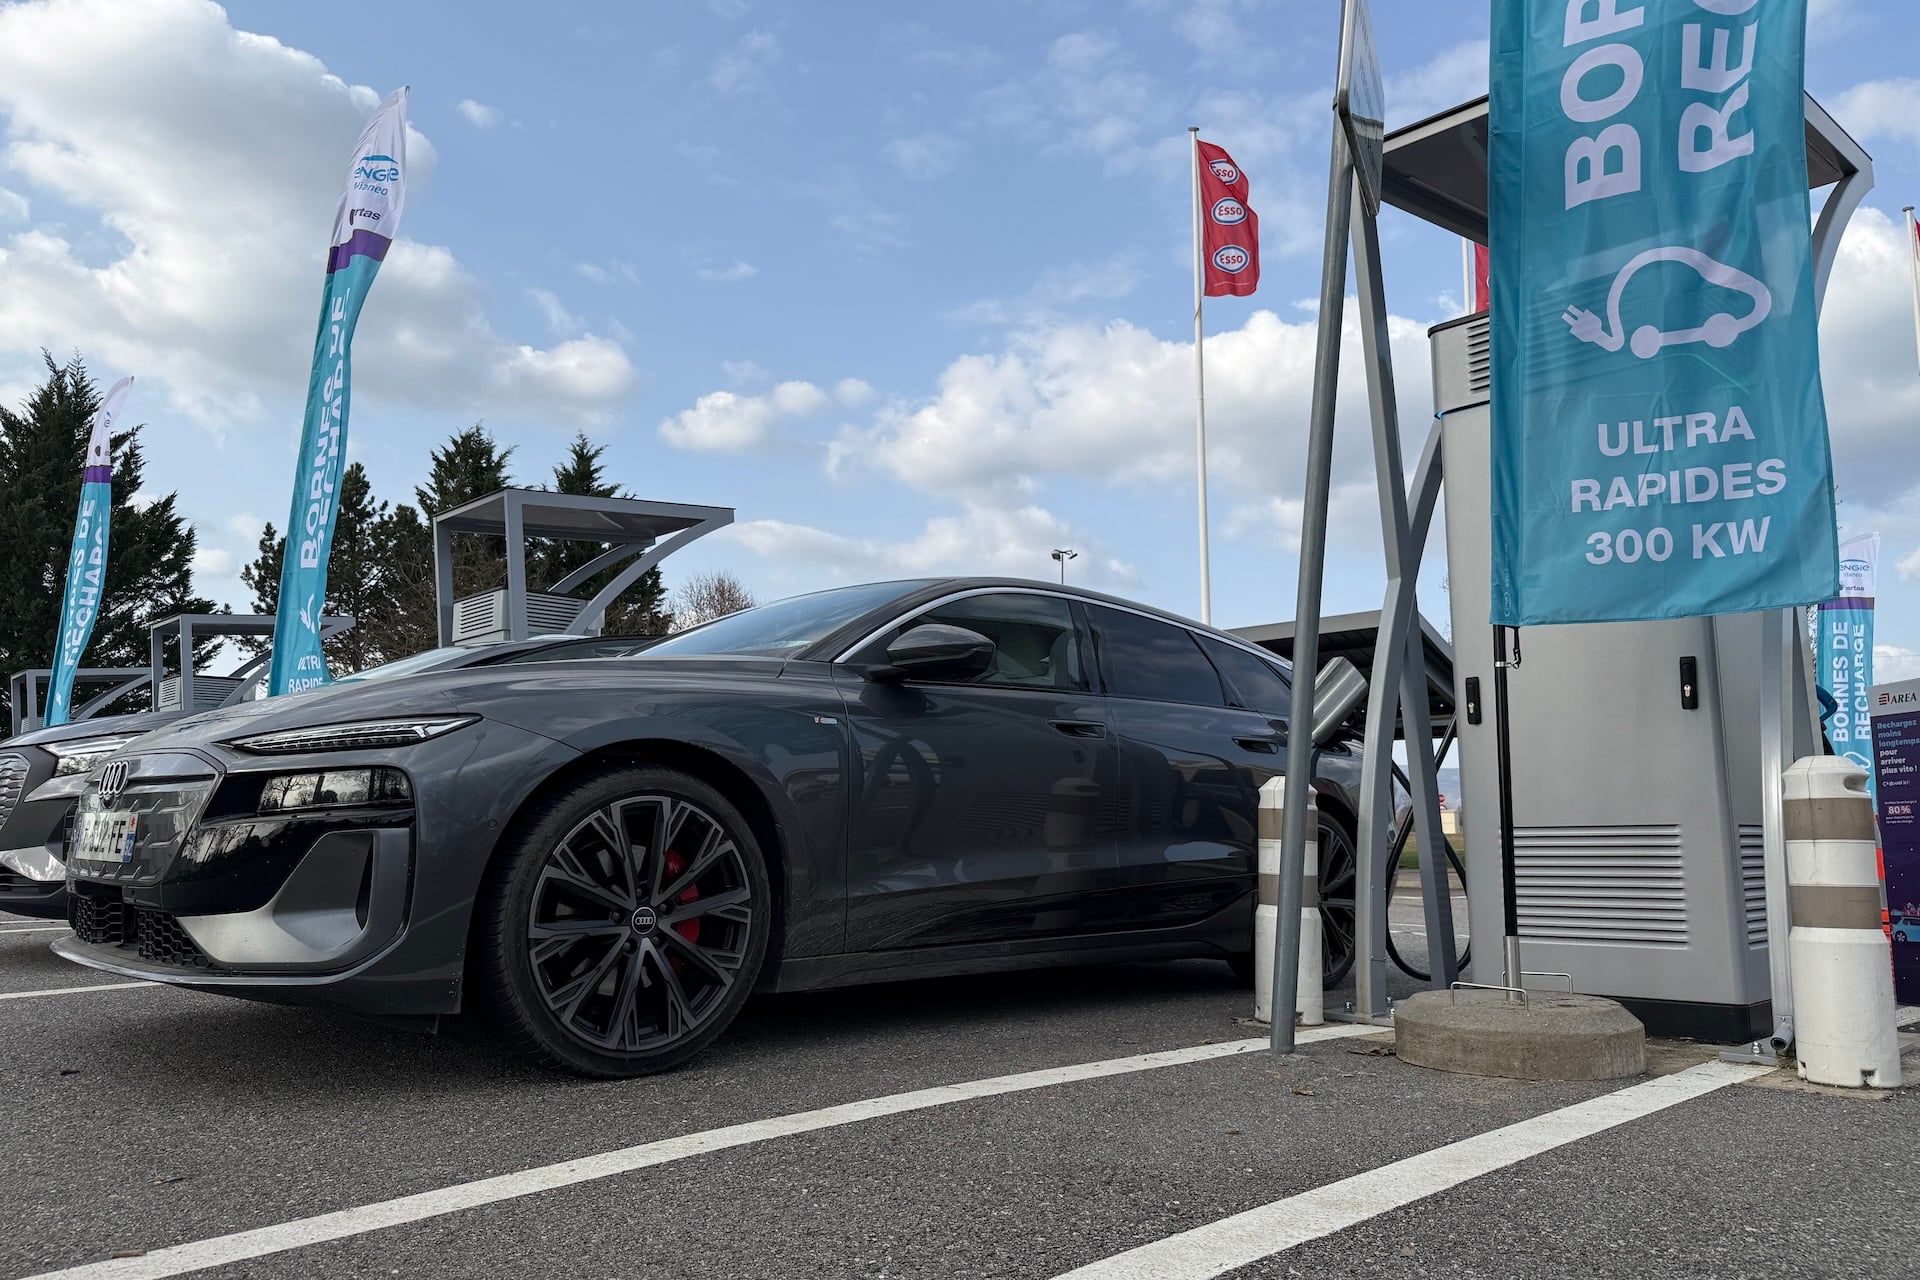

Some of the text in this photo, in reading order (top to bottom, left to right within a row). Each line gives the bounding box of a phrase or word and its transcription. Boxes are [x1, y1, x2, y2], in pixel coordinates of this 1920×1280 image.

[1677, 0, 1759, 173] RE
[1598, 406, 1756, 457] ULTRA
[1571, 459, 1787, 513] RAPIDES
[1586, 516, 1772, 565] 300 KW
[1833, 621, 1849, 650] DE
[1853, 624, 1871, 740] RECHARGE
[1890, 692, 1917, 705] AREA
[1877, 719, 1917, 730] Rechargez
[1878, 730, 1902, 739] moins
[1880, 749, 1898, 758] pour
[1880, 757, 1906, 766] arriver
[1881, 766, 1898, 776] plus
[1898, 765, 1914, 774] vite
